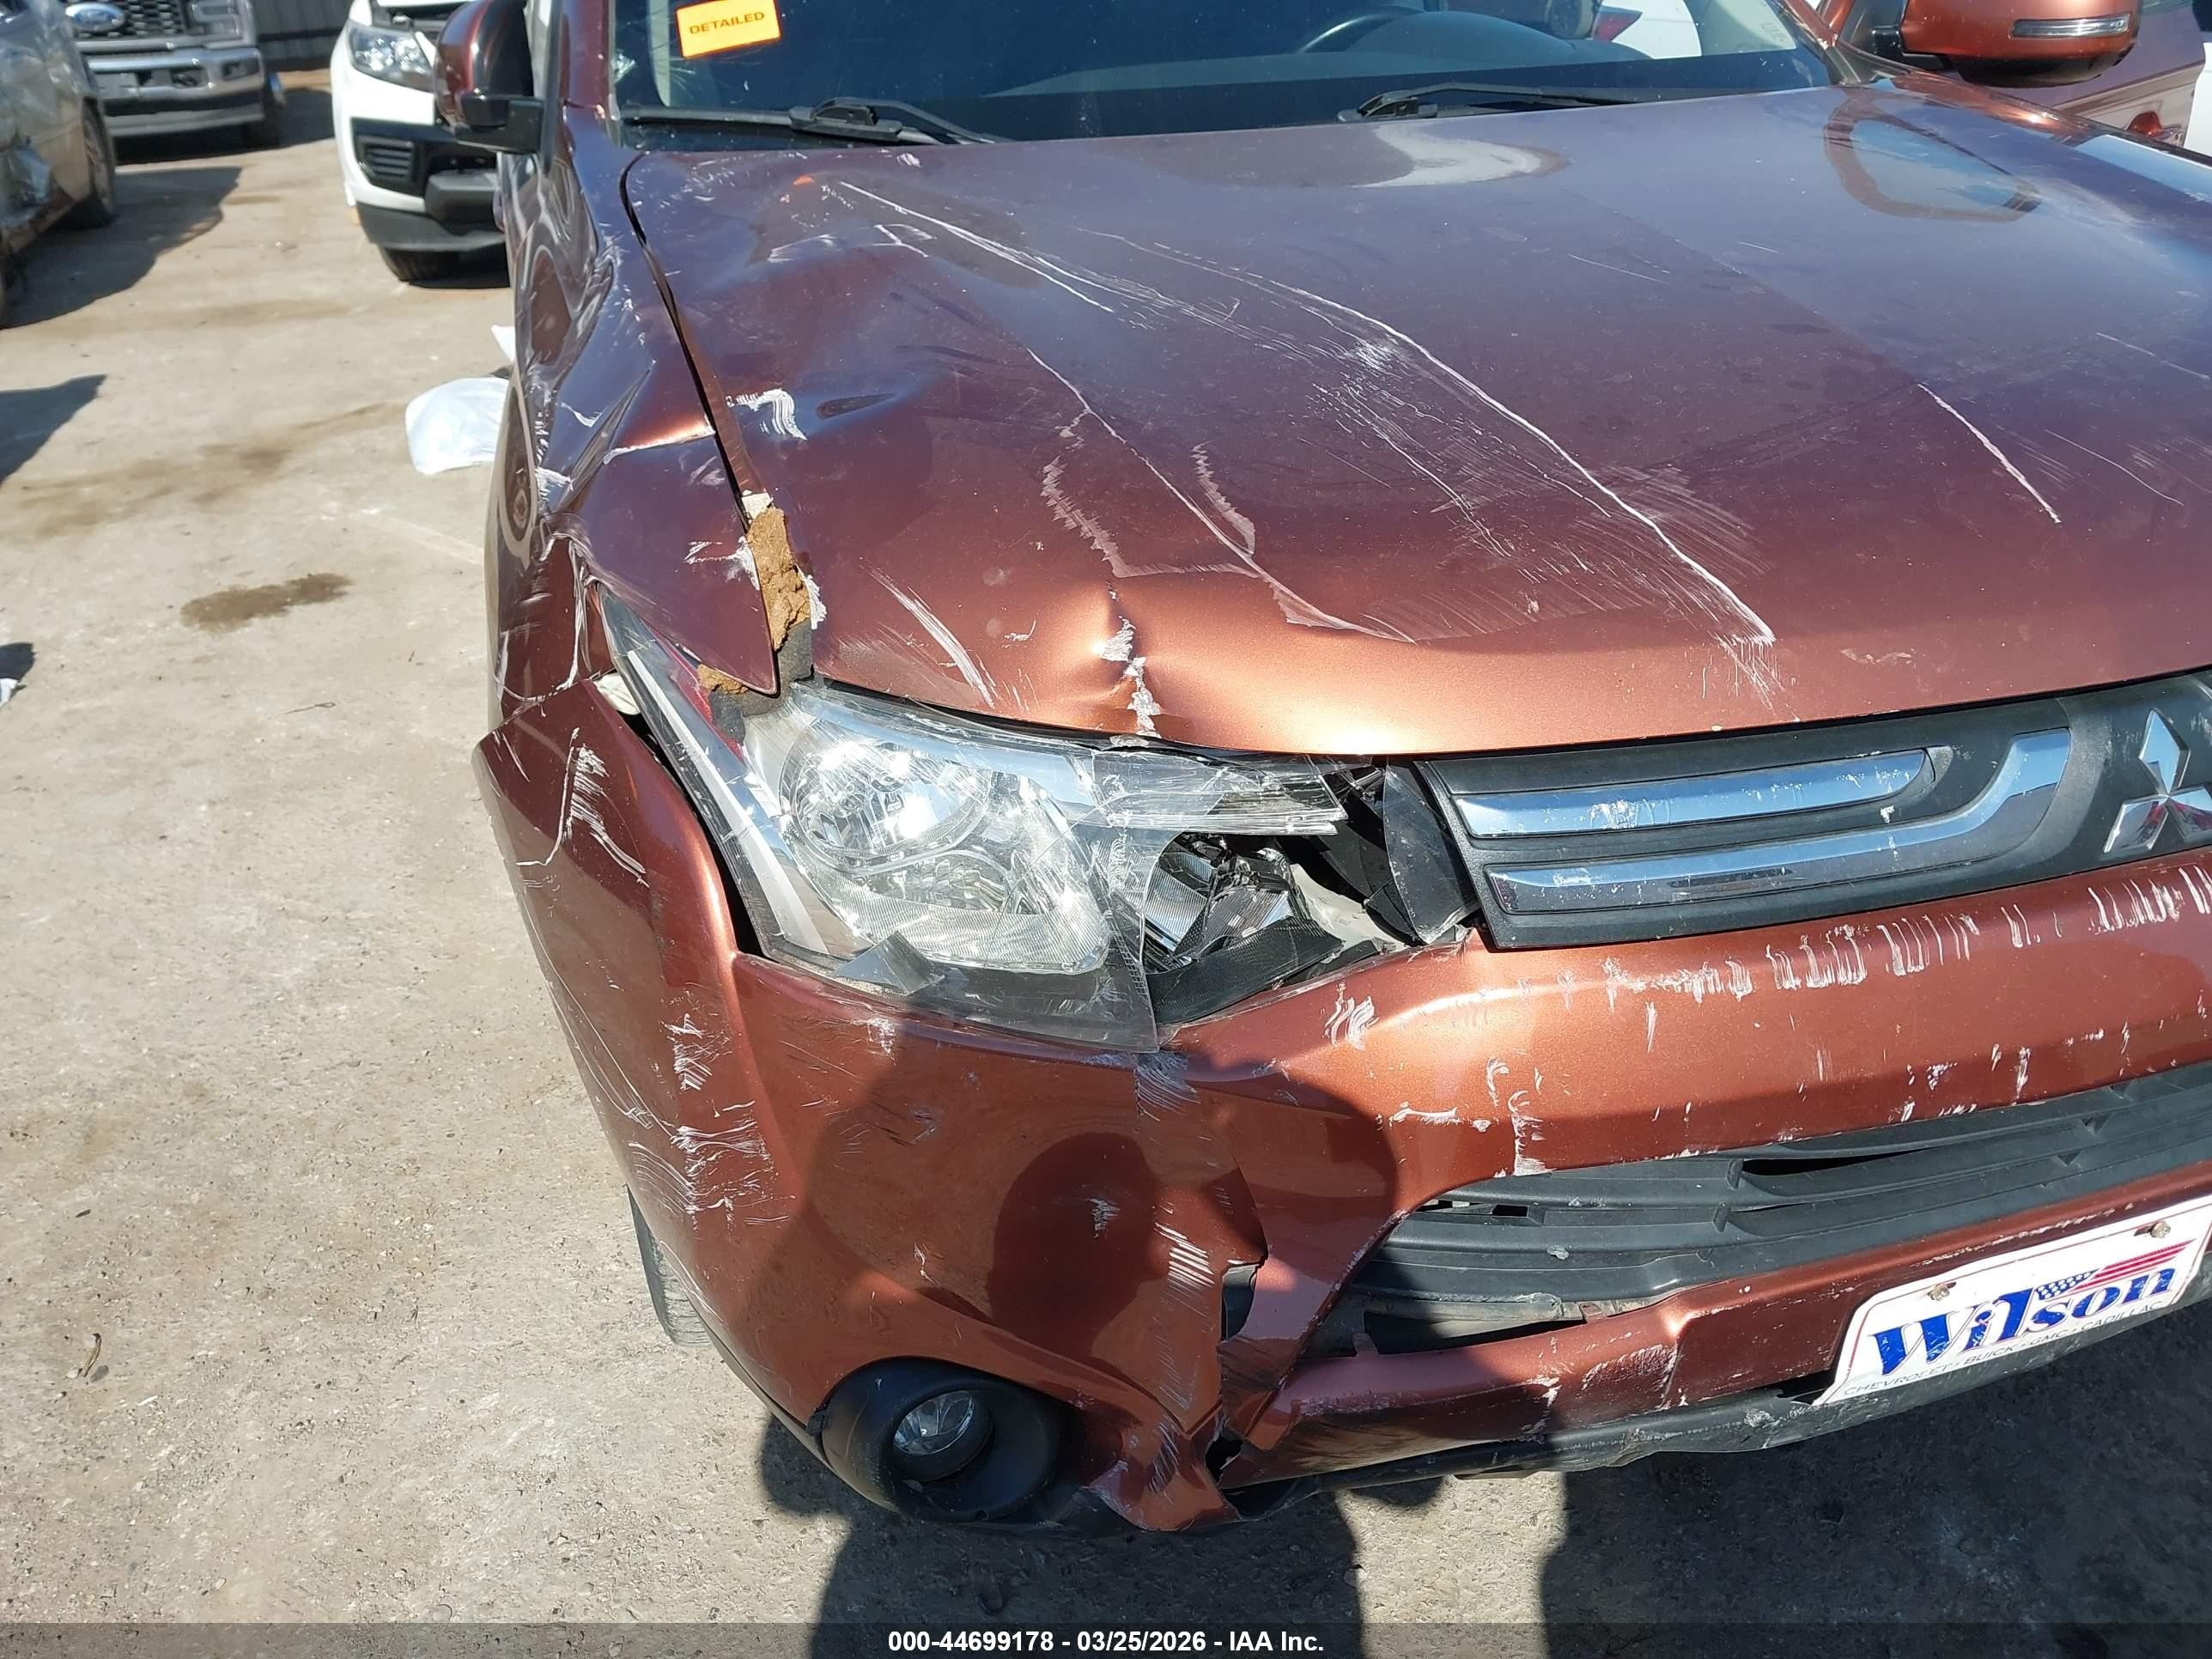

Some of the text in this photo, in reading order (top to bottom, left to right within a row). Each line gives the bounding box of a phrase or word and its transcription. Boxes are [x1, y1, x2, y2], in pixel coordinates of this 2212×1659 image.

[689, 11, 765, 34] DETAILED
[1869, 1268, 2176, 1376] Wilson
[1965, 1344, 2019, 1364] BUICK
[2029, 1328, 2068, 1346] GMC
